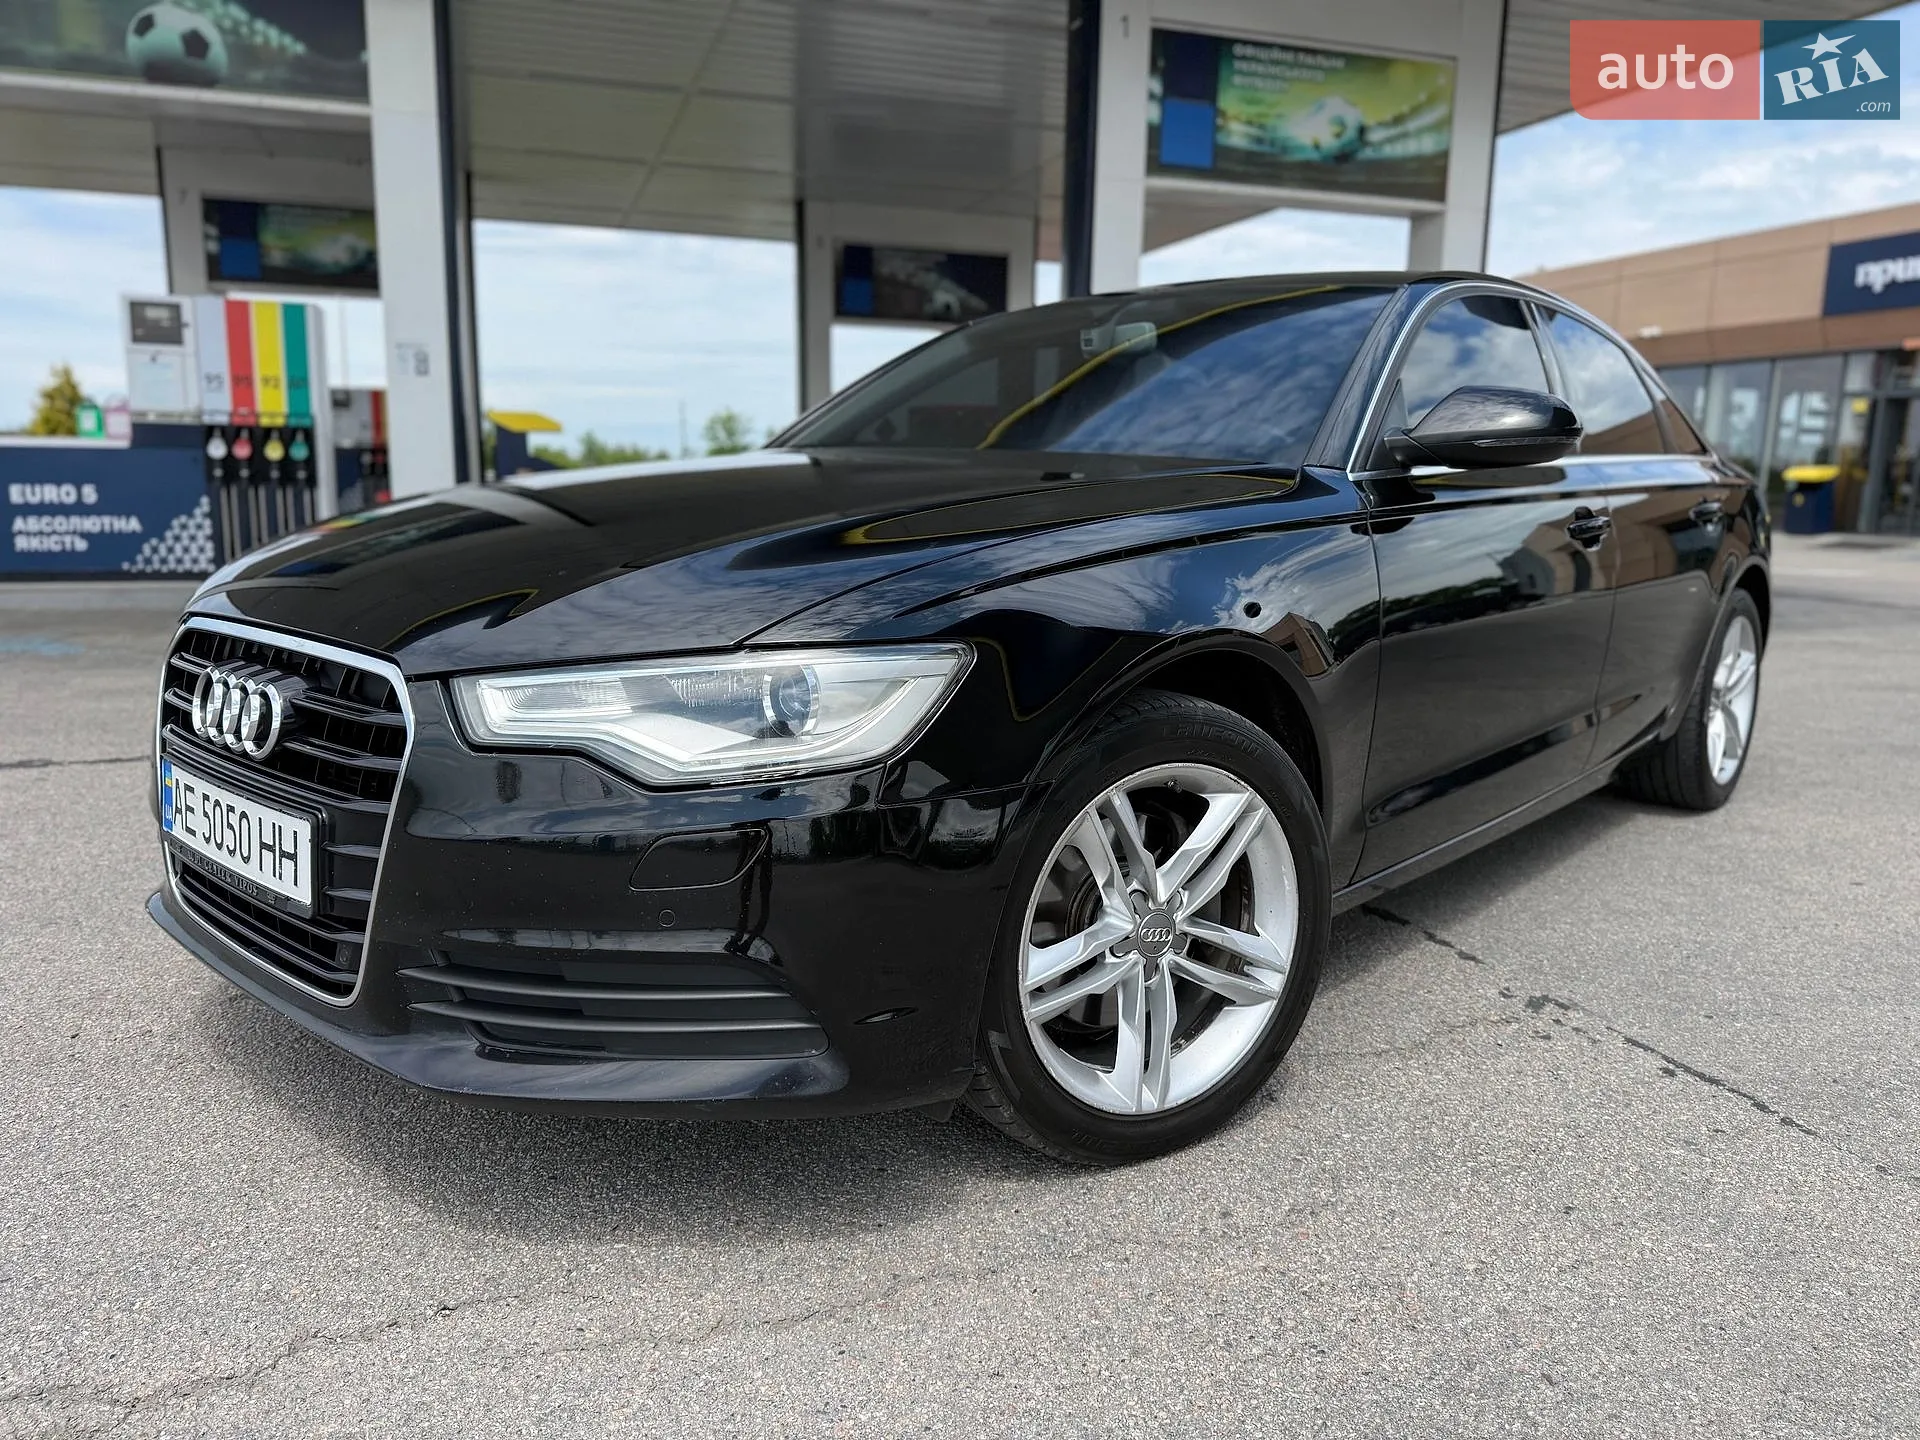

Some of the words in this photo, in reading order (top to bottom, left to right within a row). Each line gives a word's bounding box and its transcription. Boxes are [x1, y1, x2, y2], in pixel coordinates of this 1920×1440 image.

[8, 482, 78, 505] EURO
[80, 482, 99, 505] 5
[12, 514, 143, 534] АБСОЛЮТНА
[14, 533, 89, 553] ЯКІСТЬ
[173, 777, 197, 839] AE
[201, 792, 252, 865] 5050
[257, 816, 299, 888] HH
